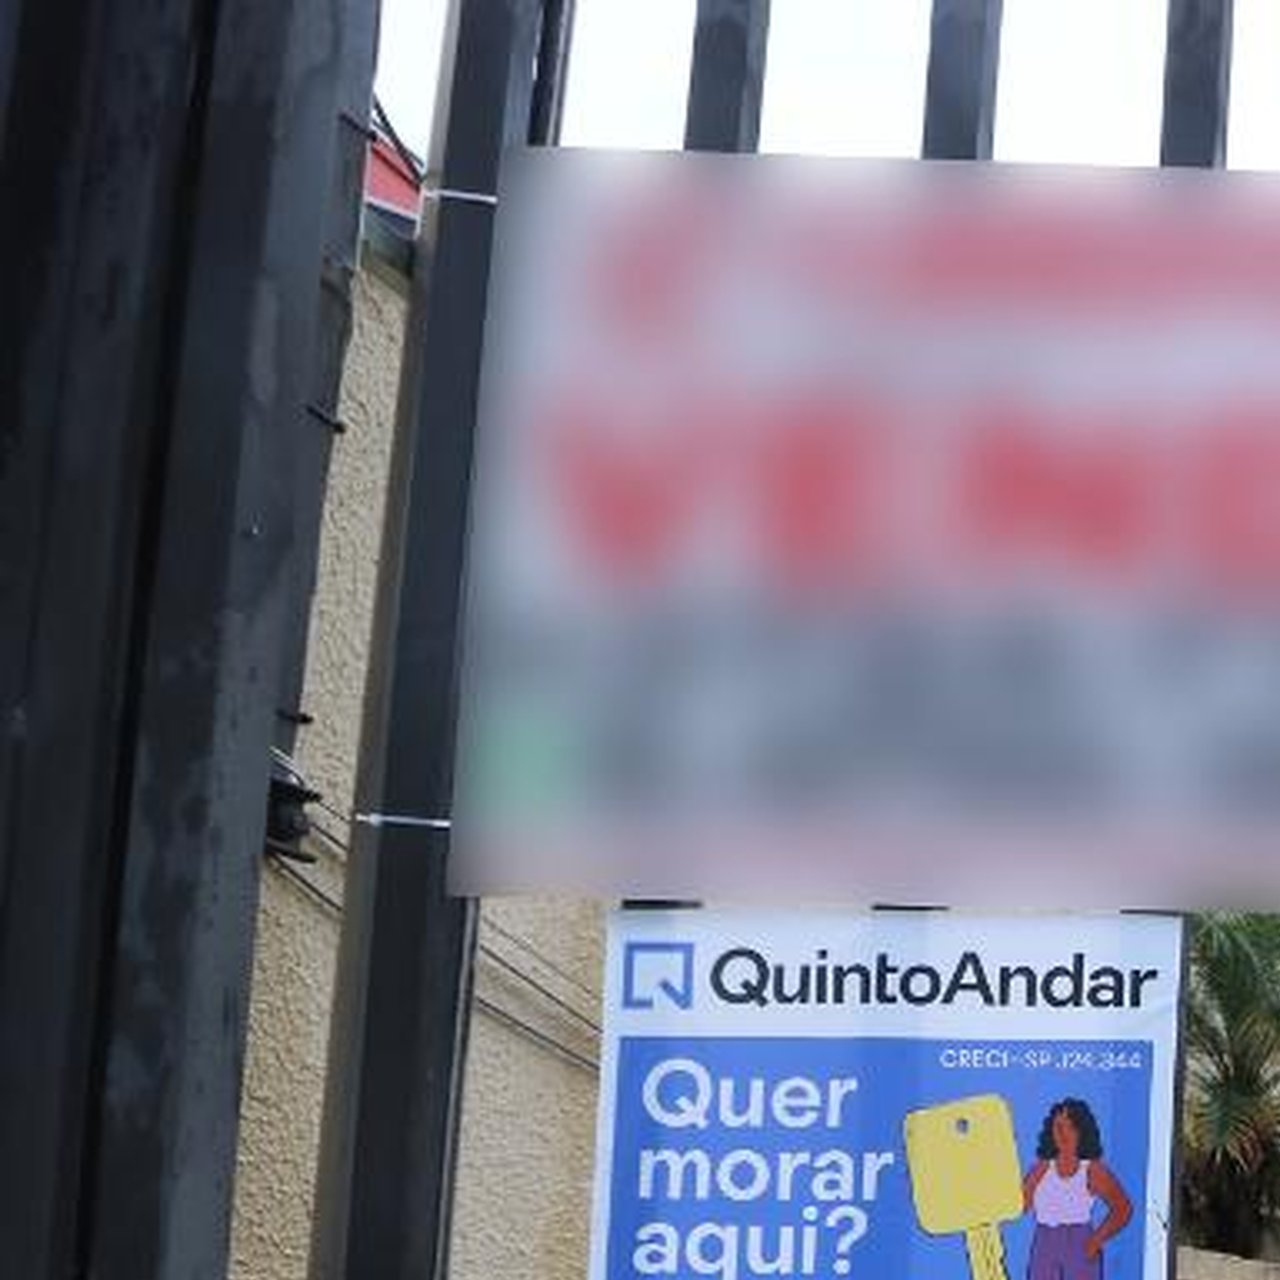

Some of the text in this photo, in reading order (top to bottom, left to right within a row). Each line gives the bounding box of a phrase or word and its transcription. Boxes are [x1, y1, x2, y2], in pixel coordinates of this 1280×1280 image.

[709, 948, 1159, 1008] QuintoAndar
[643, 1058, 857, 1129] Quer
[639, 1148, 895, 1201] morar
